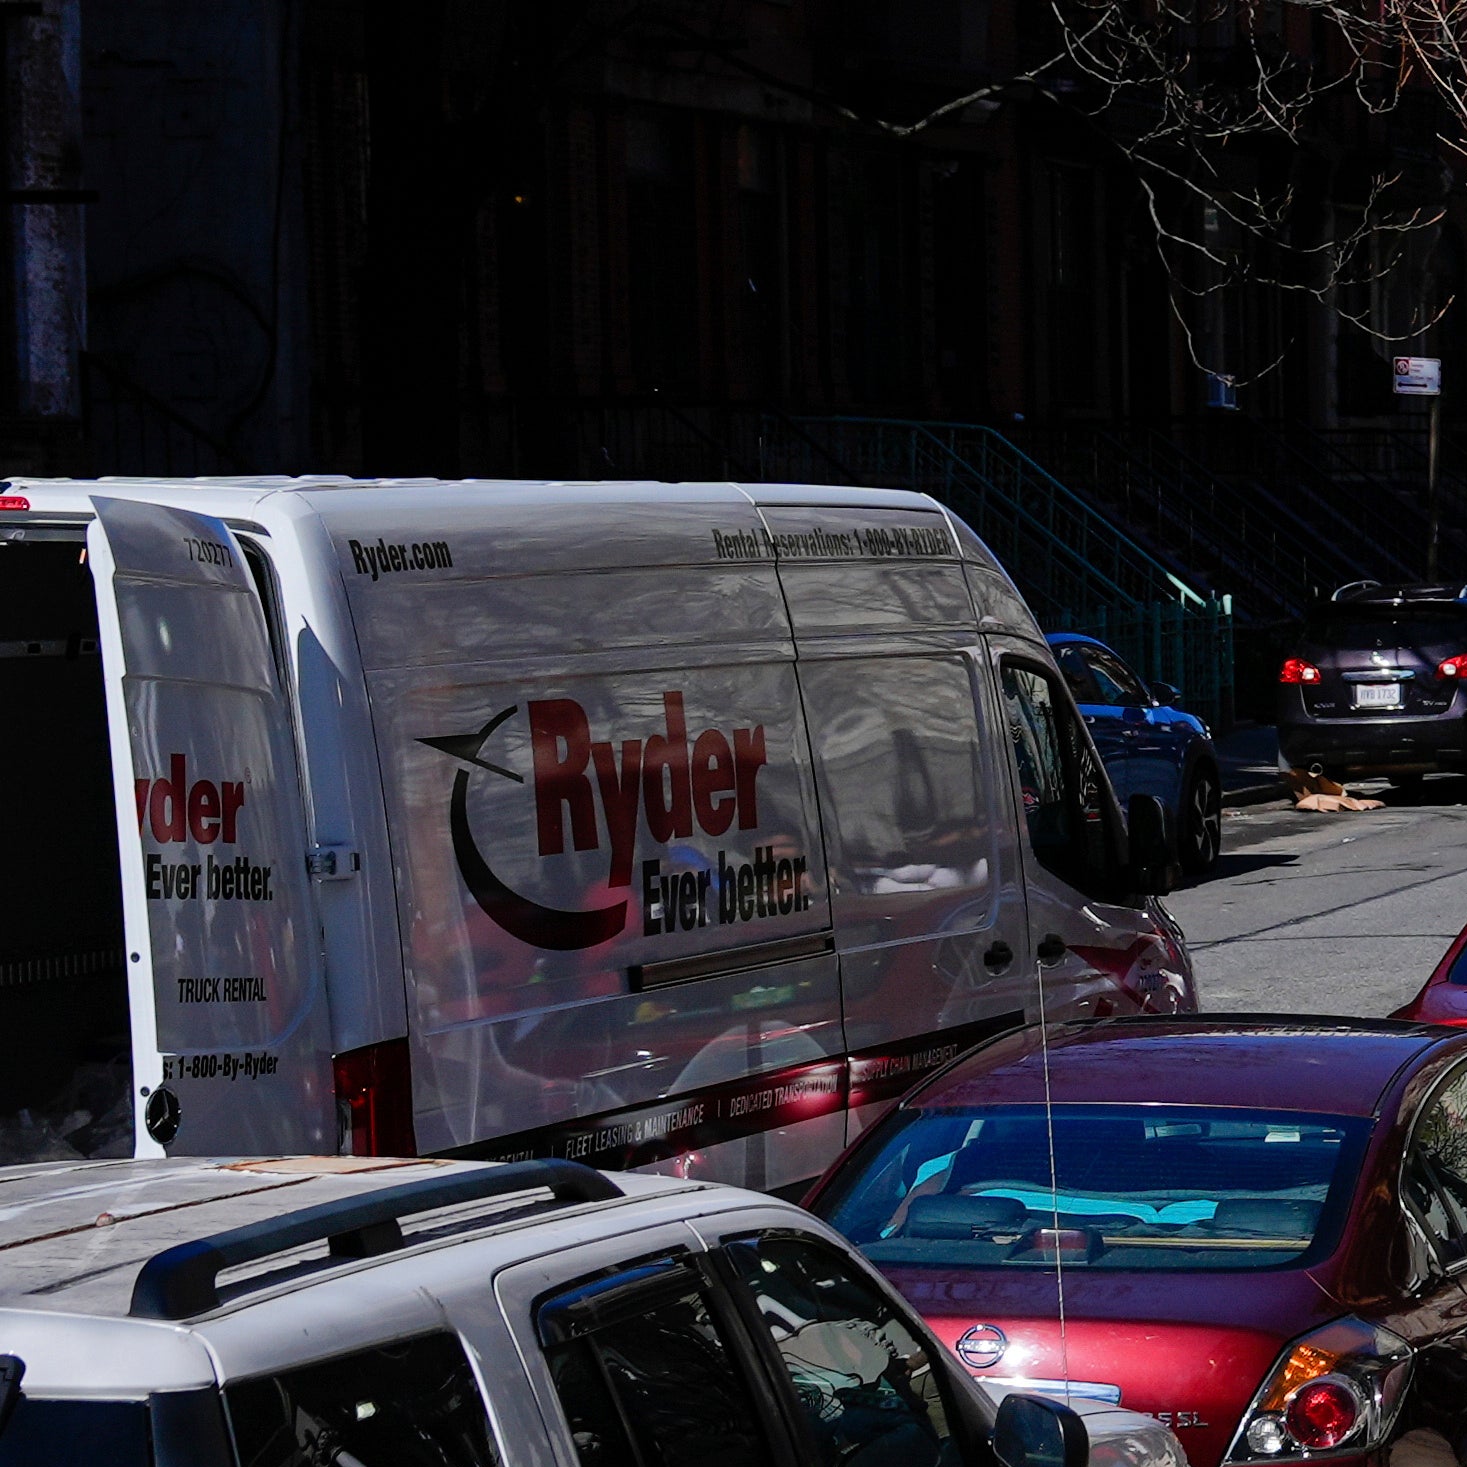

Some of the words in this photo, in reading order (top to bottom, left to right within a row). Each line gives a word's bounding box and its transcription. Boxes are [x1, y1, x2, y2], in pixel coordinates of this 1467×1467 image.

[183, 537, 233, 568] 720277
[711, 528, 759, 559] Rental
[760, 527, 854, 558] Reservations:
[856, 527, 953, 556] 1-800-BY-RYDER
[348, 537, 454, 582] Ryder.com
[528, 690, 767, 889] Ryder
[146, 853, 202, 900] Ever
[207, 854, 273, 901] better.
[642, 858, 711, 937] Ever
[718, 845, 810, 925] better.
[178, 977, 220, 1003] TRUCK
[223, 977, 267, 1002] RENTAL
[178, 1052, 279, 1081] 1-800-By-Ryder
[729, 1089, 773, 1118] DEDICATED
[566, 1134, 594, 1161] FLEET
[595, 1123, 634, 1151] LEASING
[635, 1119, 642, 1142] &
[644, 1103, 705, 1140] MAINTENANCE
[1177, 1411, 1209, 1428] SL
